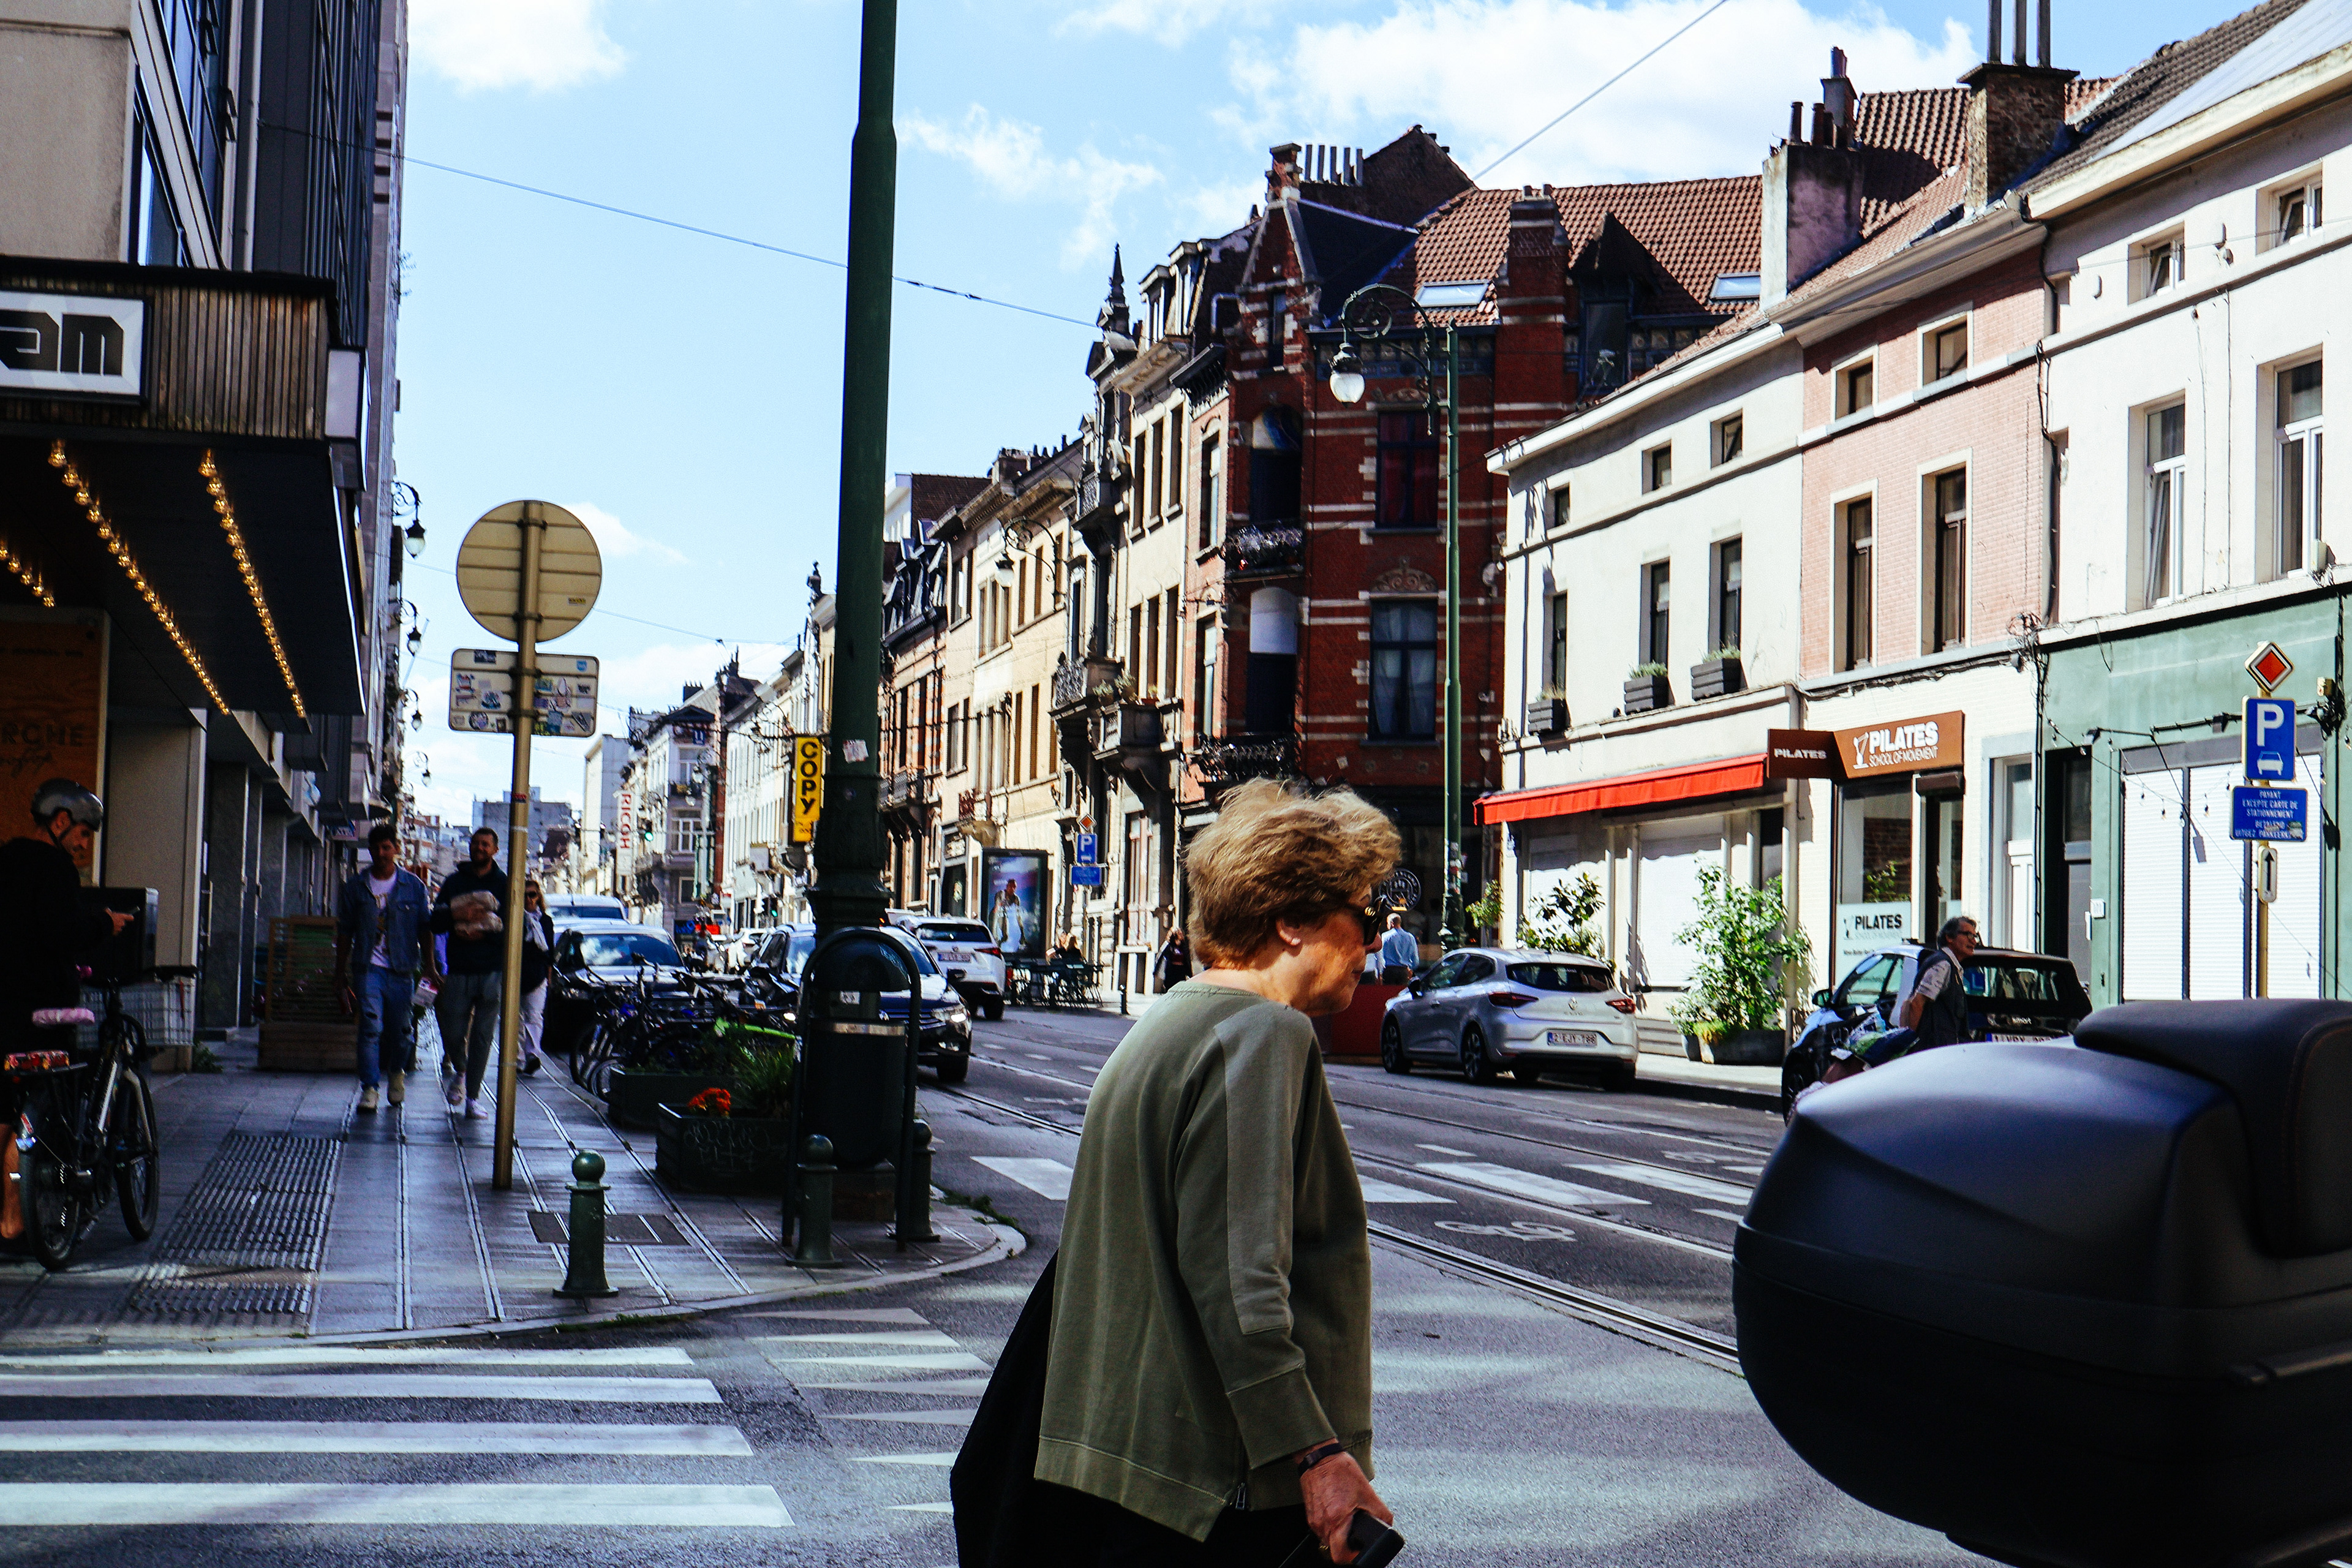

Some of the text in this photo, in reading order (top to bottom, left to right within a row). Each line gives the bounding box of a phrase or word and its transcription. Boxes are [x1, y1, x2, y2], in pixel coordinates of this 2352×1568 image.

[1869, 722, 1939, 754] PILATES
[2257, 703, 2285, 747] P
[1774, 748, 1827, 760] PILATES
[1869, 745, 1939, 767] SCHOOL OF MOVEMENT
[801, 742, 818, 815] COPY
[620, 794, 631, 848] RICOH
[1080, 835, 1093, 852] P
[1855, 914, 1902, 930] PILATES
